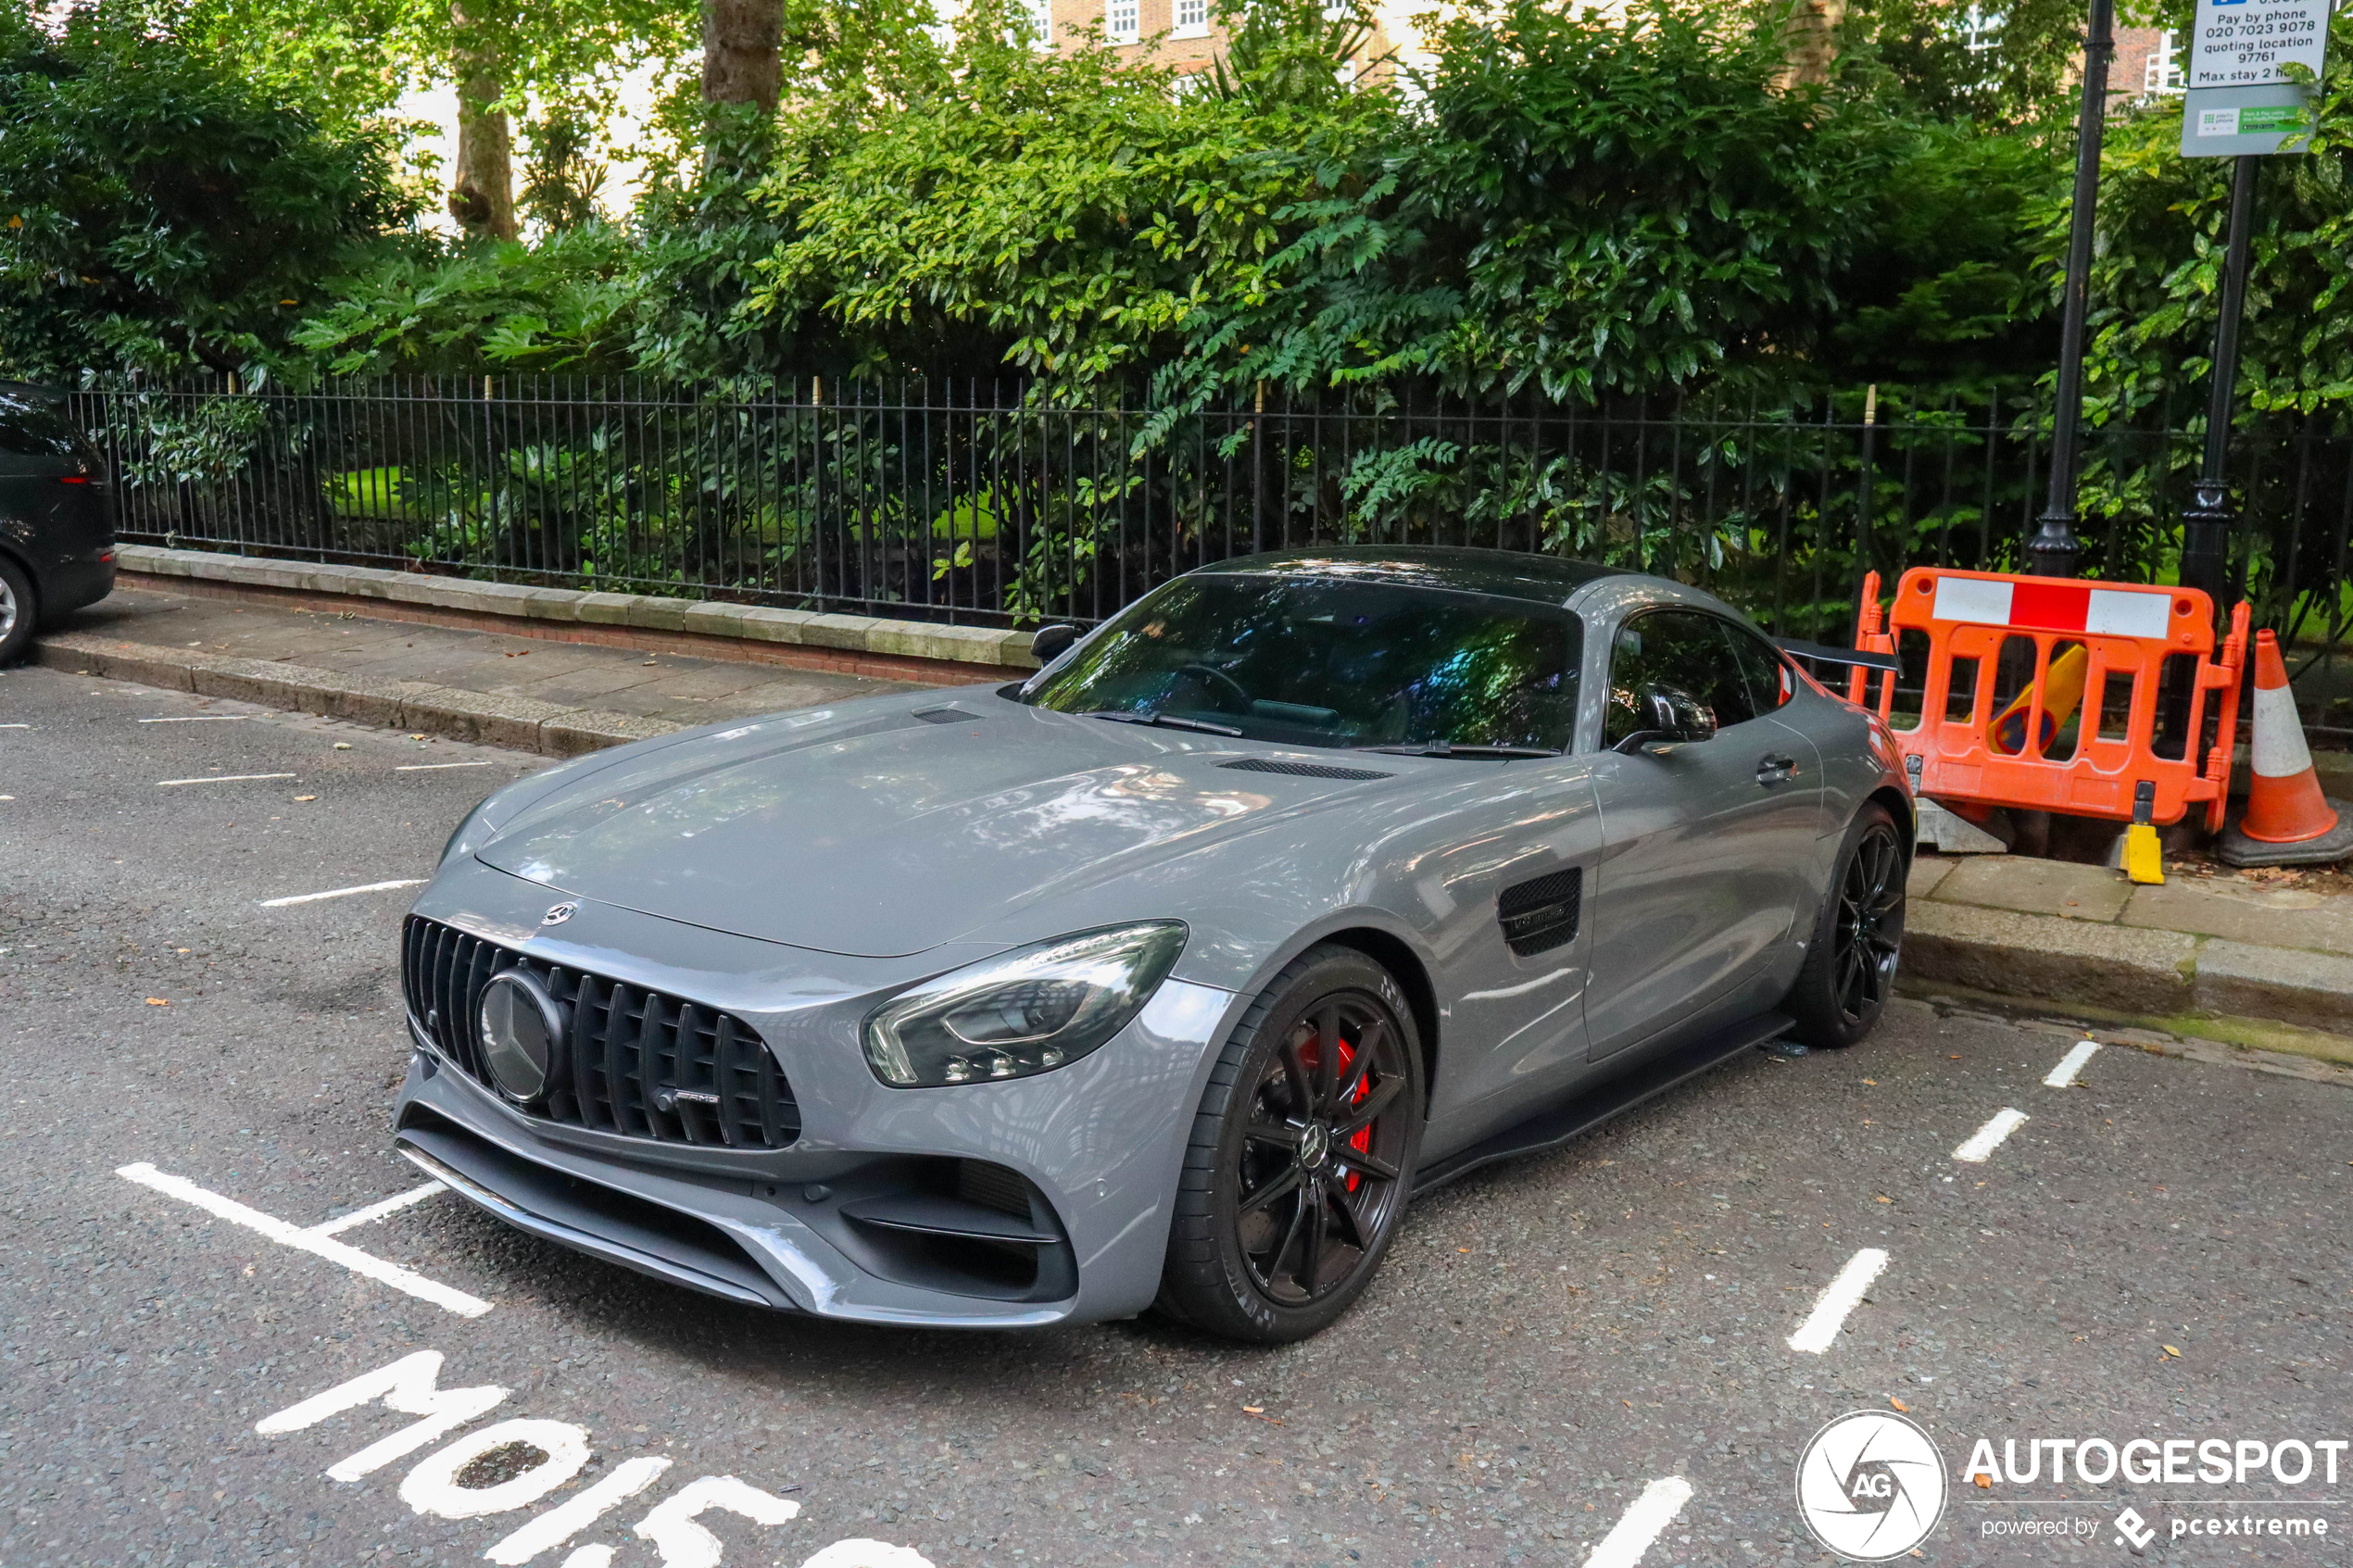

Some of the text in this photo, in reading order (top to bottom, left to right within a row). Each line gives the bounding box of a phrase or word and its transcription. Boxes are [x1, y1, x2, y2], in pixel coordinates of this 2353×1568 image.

[2217, 10, 2307, 26] Pay by phone
[2206, 20, 2315, 38] 020 7023 9078
[2205, 37, 2313, 54] quoting location
[2238, 52, 2275, 63] 97761
[2199, 71, 2225, 82] Max
[2231, 70, 2258, 81] stay
[2262, 68, 2271, 78] 2
